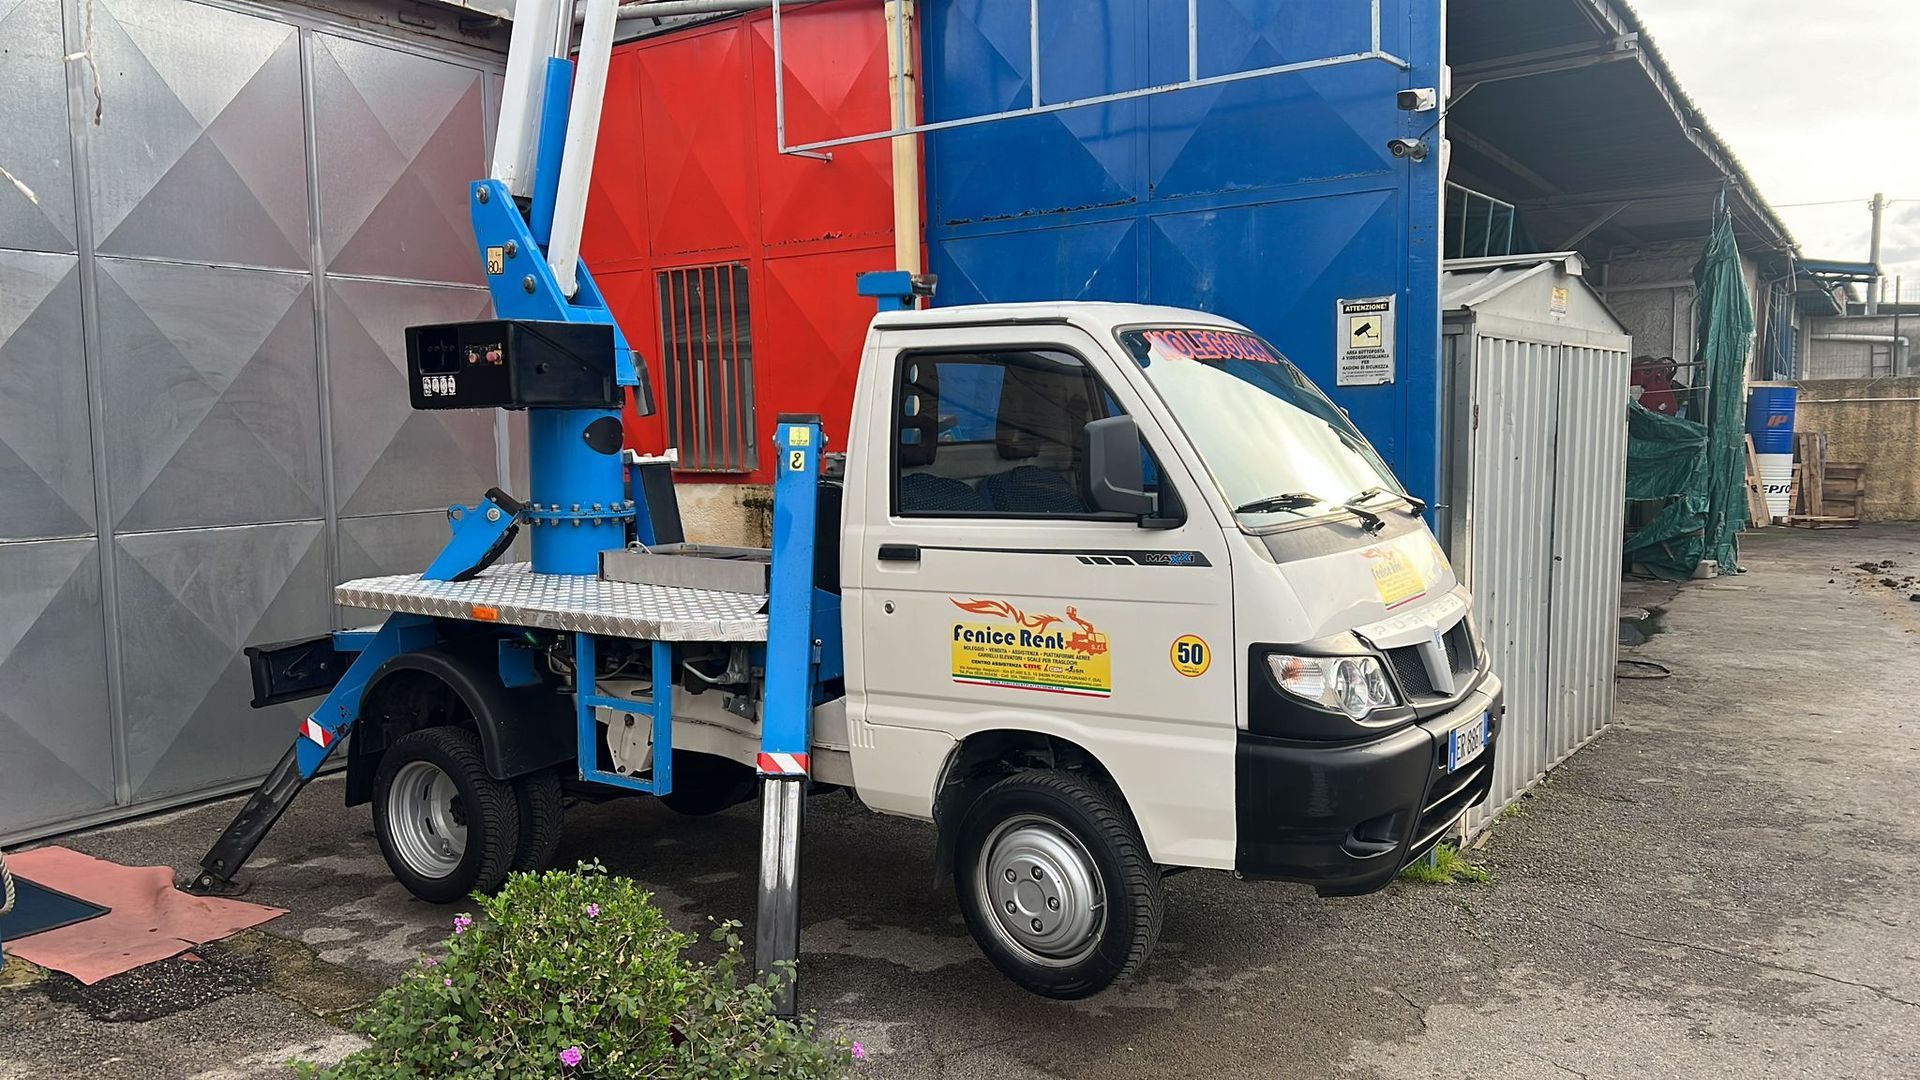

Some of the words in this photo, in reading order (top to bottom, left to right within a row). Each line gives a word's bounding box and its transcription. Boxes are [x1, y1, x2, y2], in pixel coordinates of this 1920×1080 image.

[489, 261, 498, 273] 80
[1345, 303, 1387, 312] ATTENZIONE!
[1768, 415, 1788, 427] IP
[954, 624, 1015, 646] Fenice
[1020, 629, 1064, 650] Rent
[1177, 641, 1204, 666] 50
